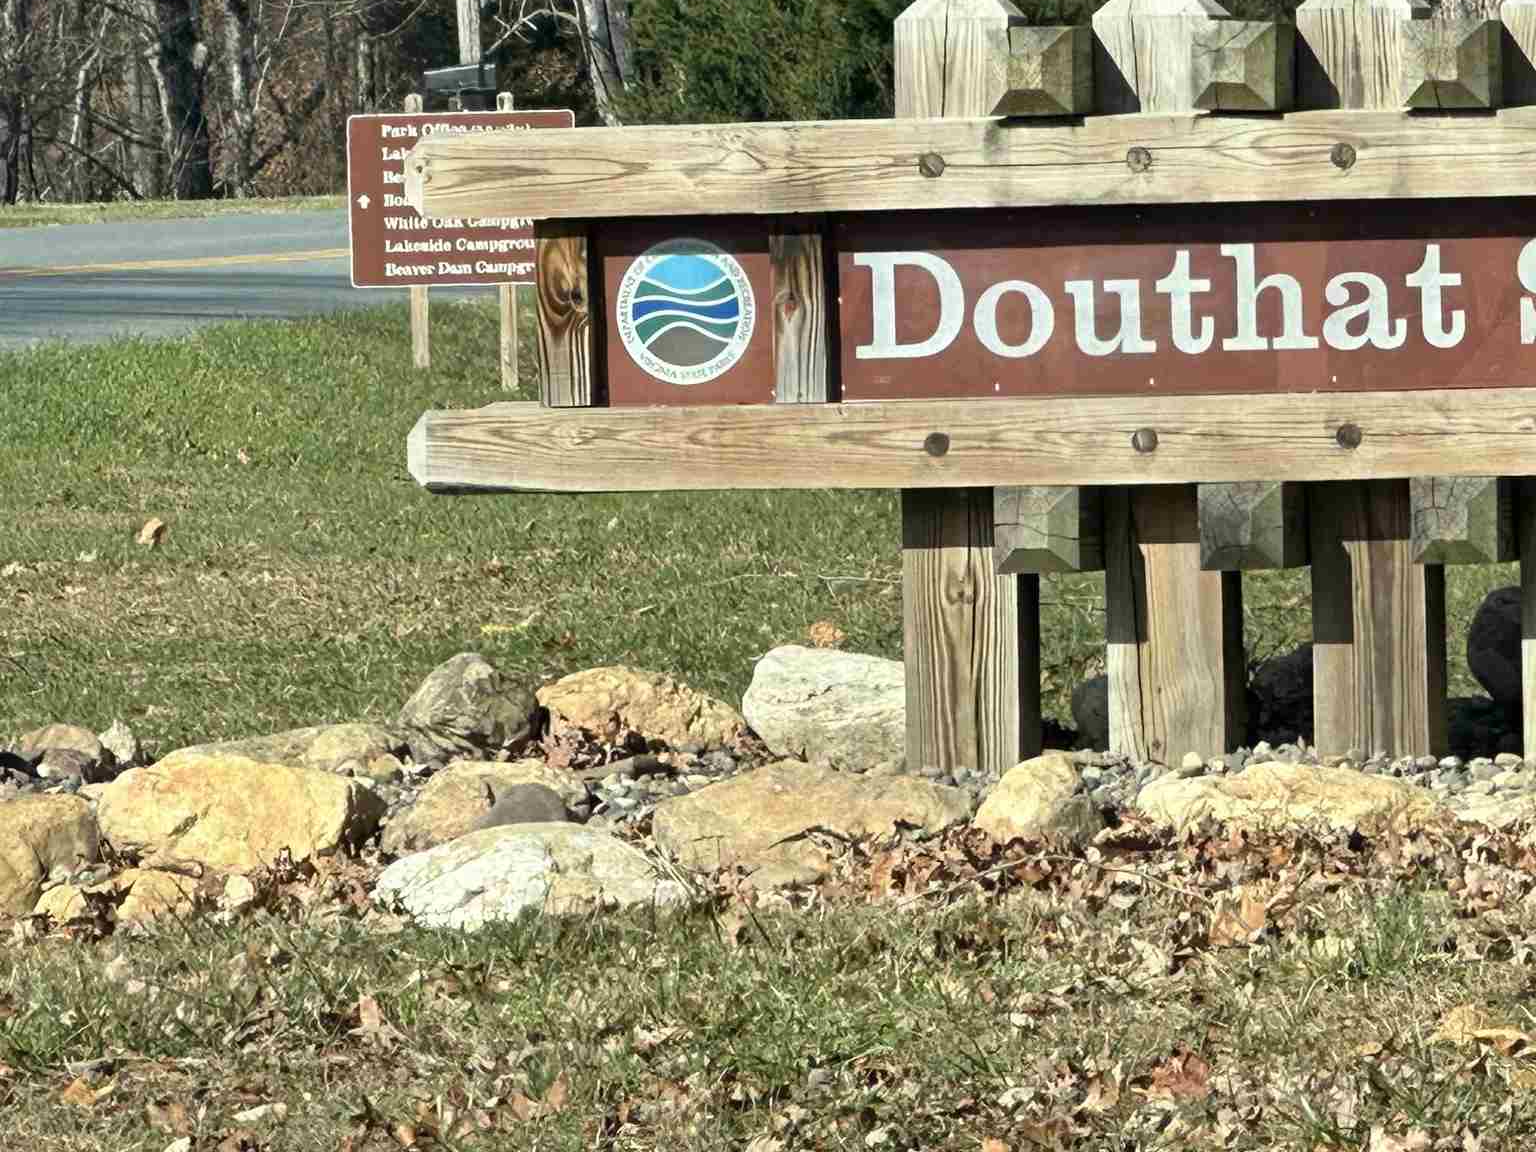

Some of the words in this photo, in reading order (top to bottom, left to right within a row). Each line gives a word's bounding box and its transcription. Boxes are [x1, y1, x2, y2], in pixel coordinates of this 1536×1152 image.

[381, 124, 418, 138] Park
[381, 146, 407, 161] Lak
[384, 215, 428, 230] White
[431, 217, 463, 229] Oak
[384, 238, 451, 253] Lakeside
[455, 237, 535, 253] Campgrou
[384, 262, 436, 276] Beaver
[438, 262, 473, 275] Dam
[475, 261, 536, 275] Campgr
[854, 243, 1466, 359] Douthat
